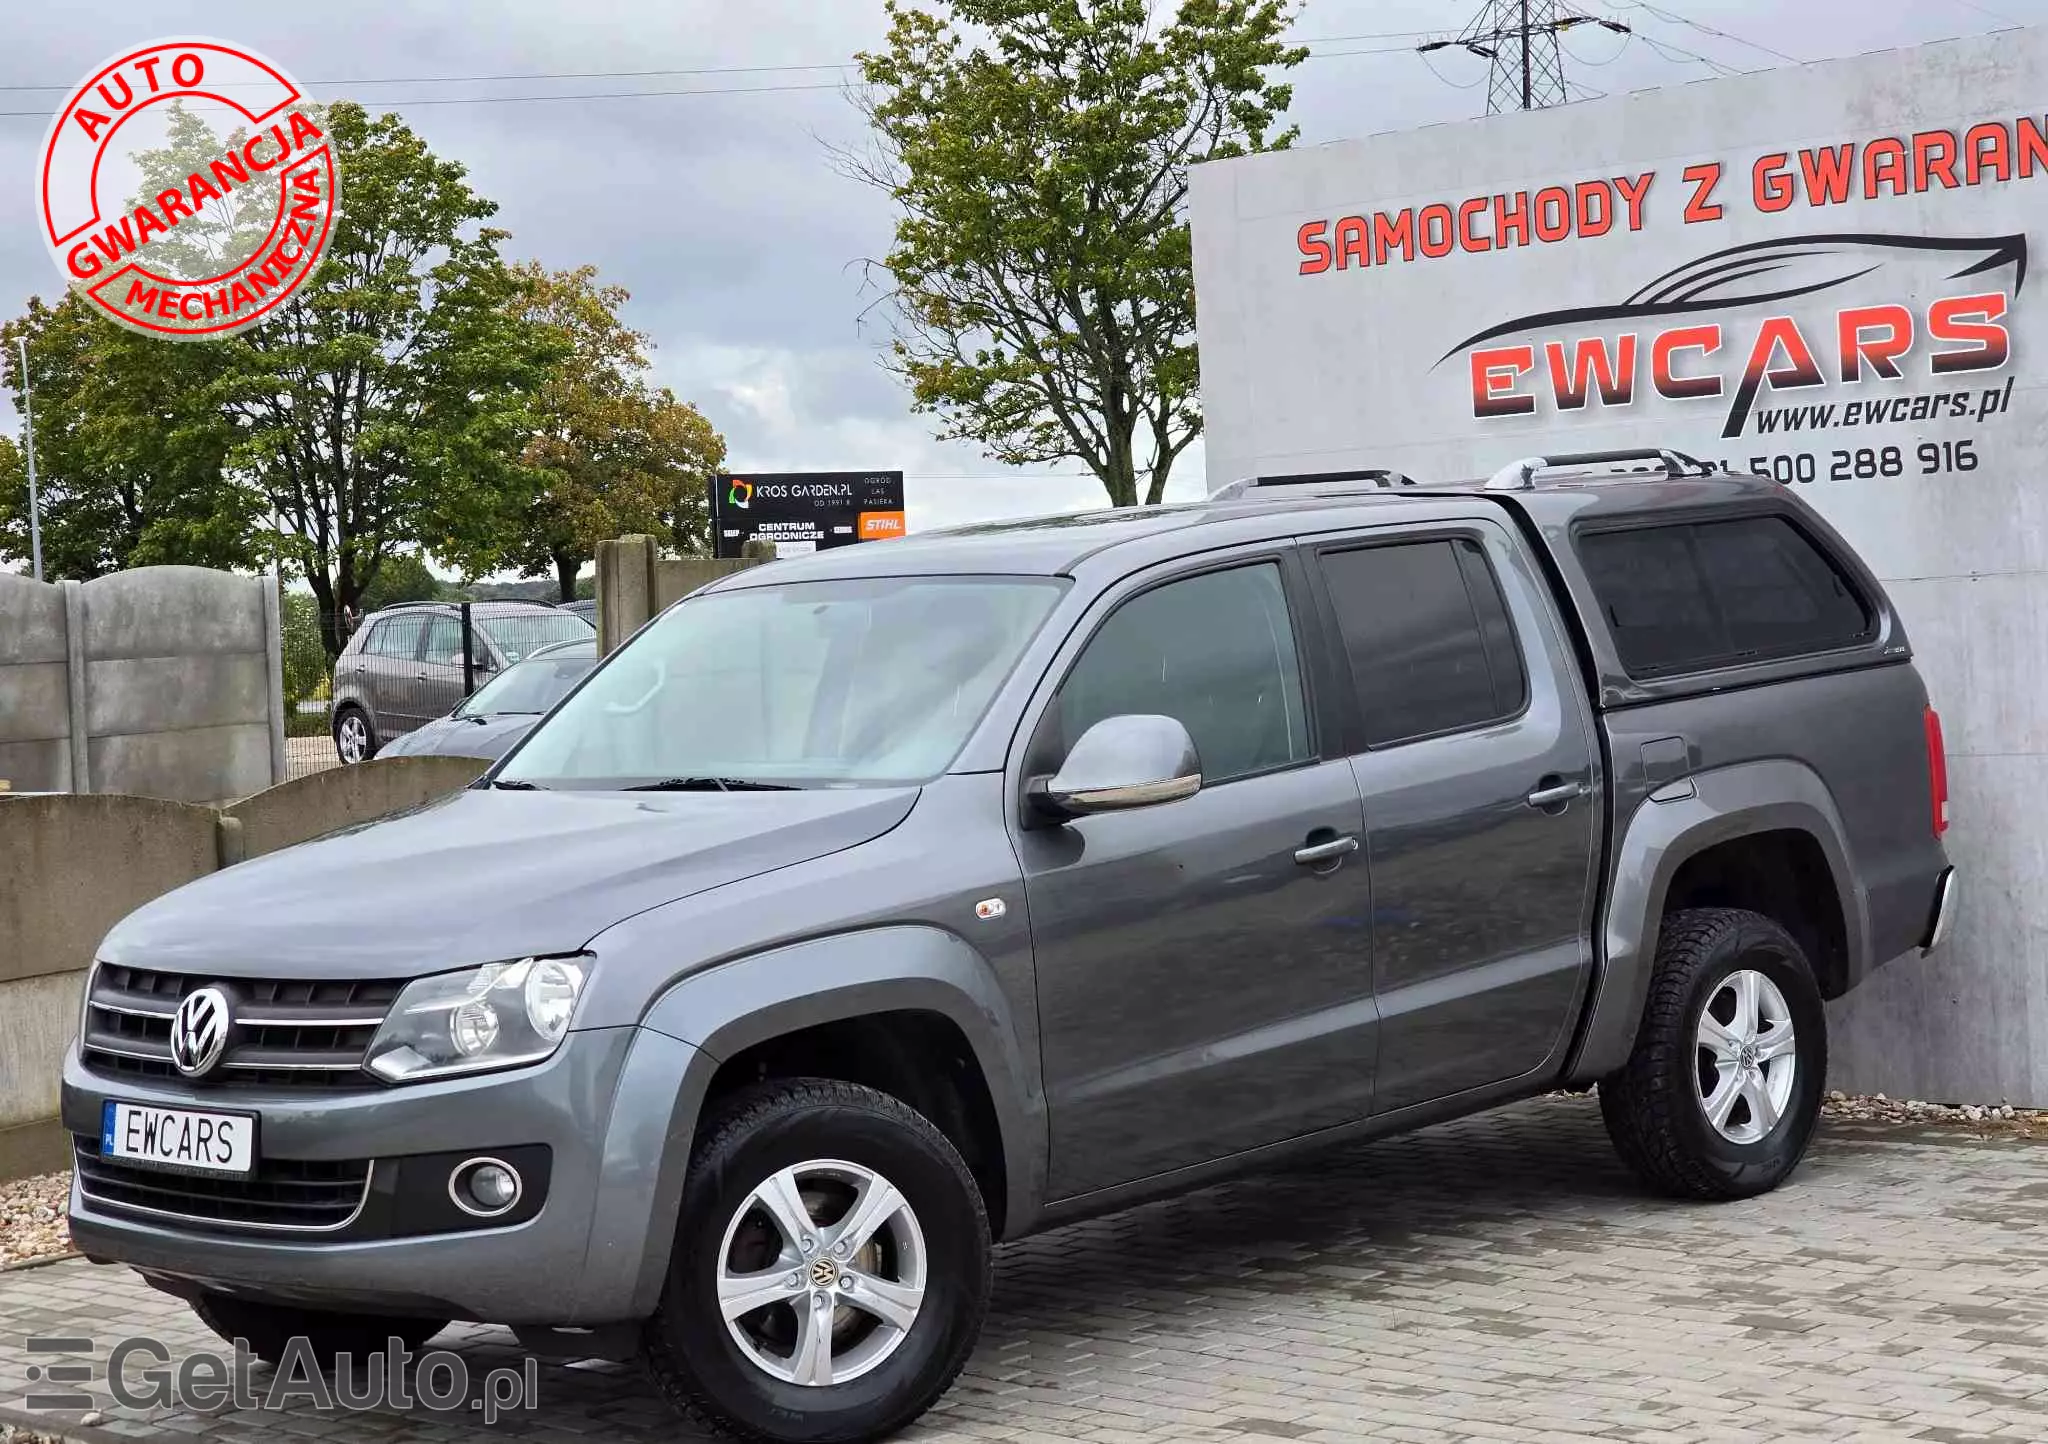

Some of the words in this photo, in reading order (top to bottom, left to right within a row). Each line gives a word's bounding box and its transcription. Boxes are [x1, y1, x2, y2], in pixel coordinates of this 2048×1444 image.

[1298, 172, 1656, 276] SAMOCHODY
[1682, 162, 1724, 226] Z
[1470, 292, 2011, 440] EWCARS
[1757, 376, 2015, 434] www.ewcars.pl
[1750, 453, 1816, 485] 500
[1831, 446, 1903, 481] 288
[1917, 440, 1979, 474] 916
[756, 485, 787, 497] KROS
[791, 484, 852, 496] GARDEN.PL
[749, 531, 824, 541] OGRODNICZE
[759, 522, 815, 531] CENTRUM
[865, 519, 901, 530] STIHL
[105, 1134, 114, 1146] PL
[126, 1110, 233, 1164] EWCARS
